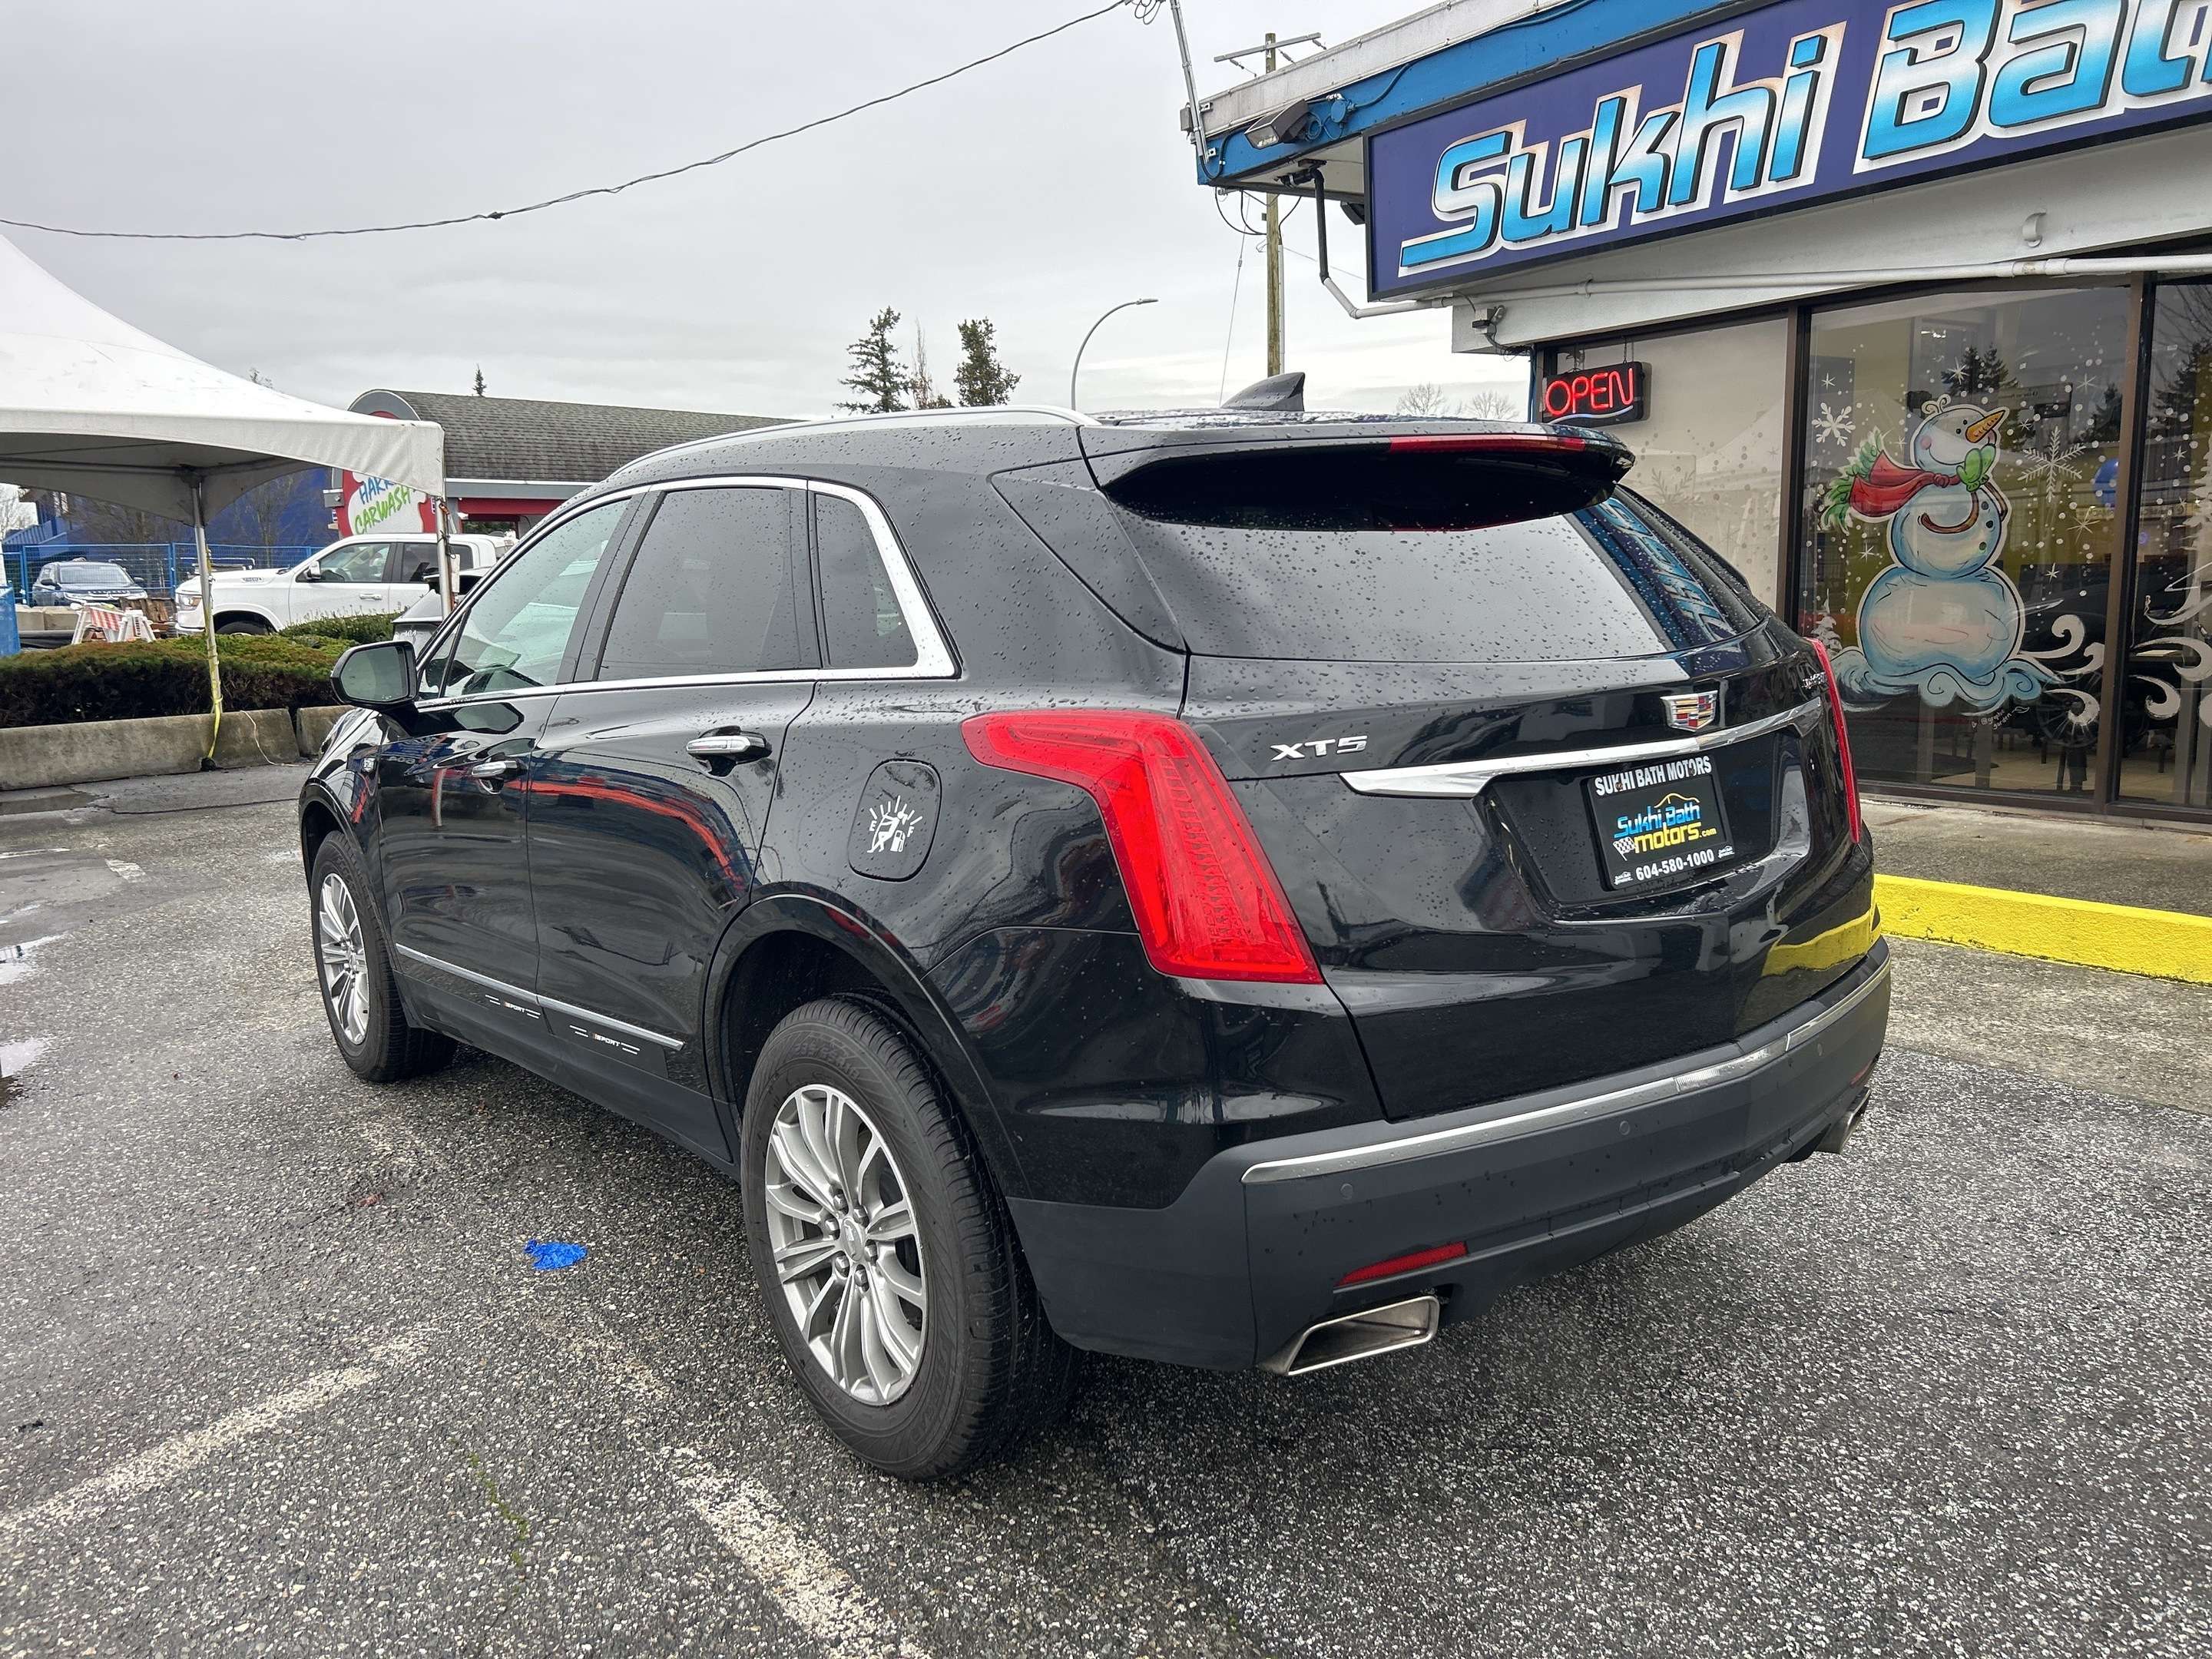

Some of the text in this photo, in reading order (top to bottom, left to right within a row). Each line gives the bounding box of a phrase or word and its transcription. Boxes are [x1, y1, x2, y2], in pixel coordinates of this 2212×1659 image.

[1399, 26, 1839, 271] Sukhi
[1545, 369, 1634, 416] OPEN
[354, 485, 411, 535] CARWASH
[1270, 735, 1368, 762] XT5
[1594, 755, 1713, 796] SUKHI BATH MOTORS
[1614, 802, 1701, 839] Sukhi Bath
[1635, 848, 1715, 882] 604-580-1000
